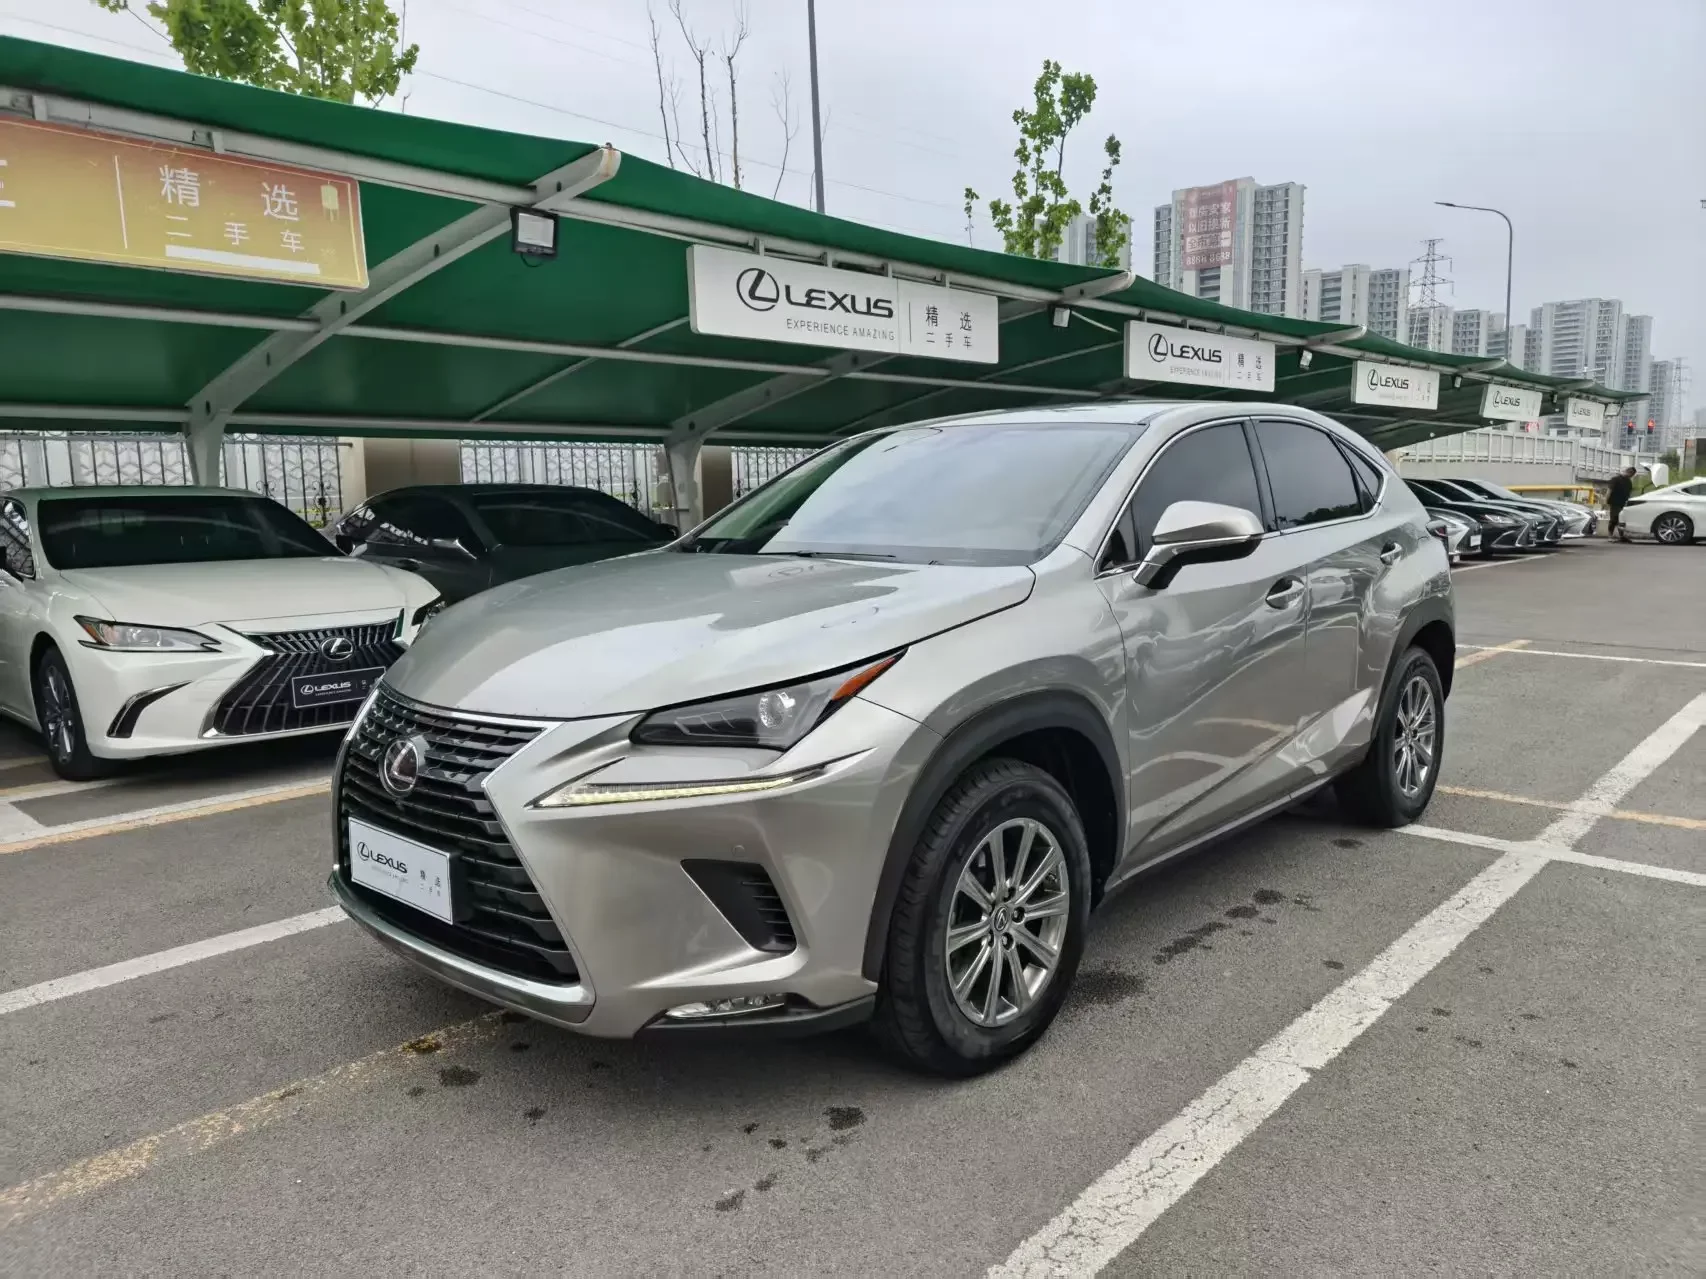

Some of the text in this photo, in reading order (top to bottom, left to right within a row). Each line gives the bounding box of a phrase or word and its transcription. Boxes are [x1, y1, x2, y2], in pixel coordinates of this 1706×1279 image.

[159, 164, 300, 222] 精选
[165, 215, 306, 253] 二手车
[784, 284, 894, 319] LEXUS
[786, 318, 895, 342] EXPERIENCE AMAZING
[925, 304, 973, 332] 精选
[925, 332, 973, 349] 二手车
[1170, 343, 1222, 364] LEXUS
[1379, 376, 1409, 390] LEXUS
[1500, 395, 1521, 408] LEXUS
[314, 681, 352, 692] LEXUS
[370, 849, 408, 874] LEXUS
